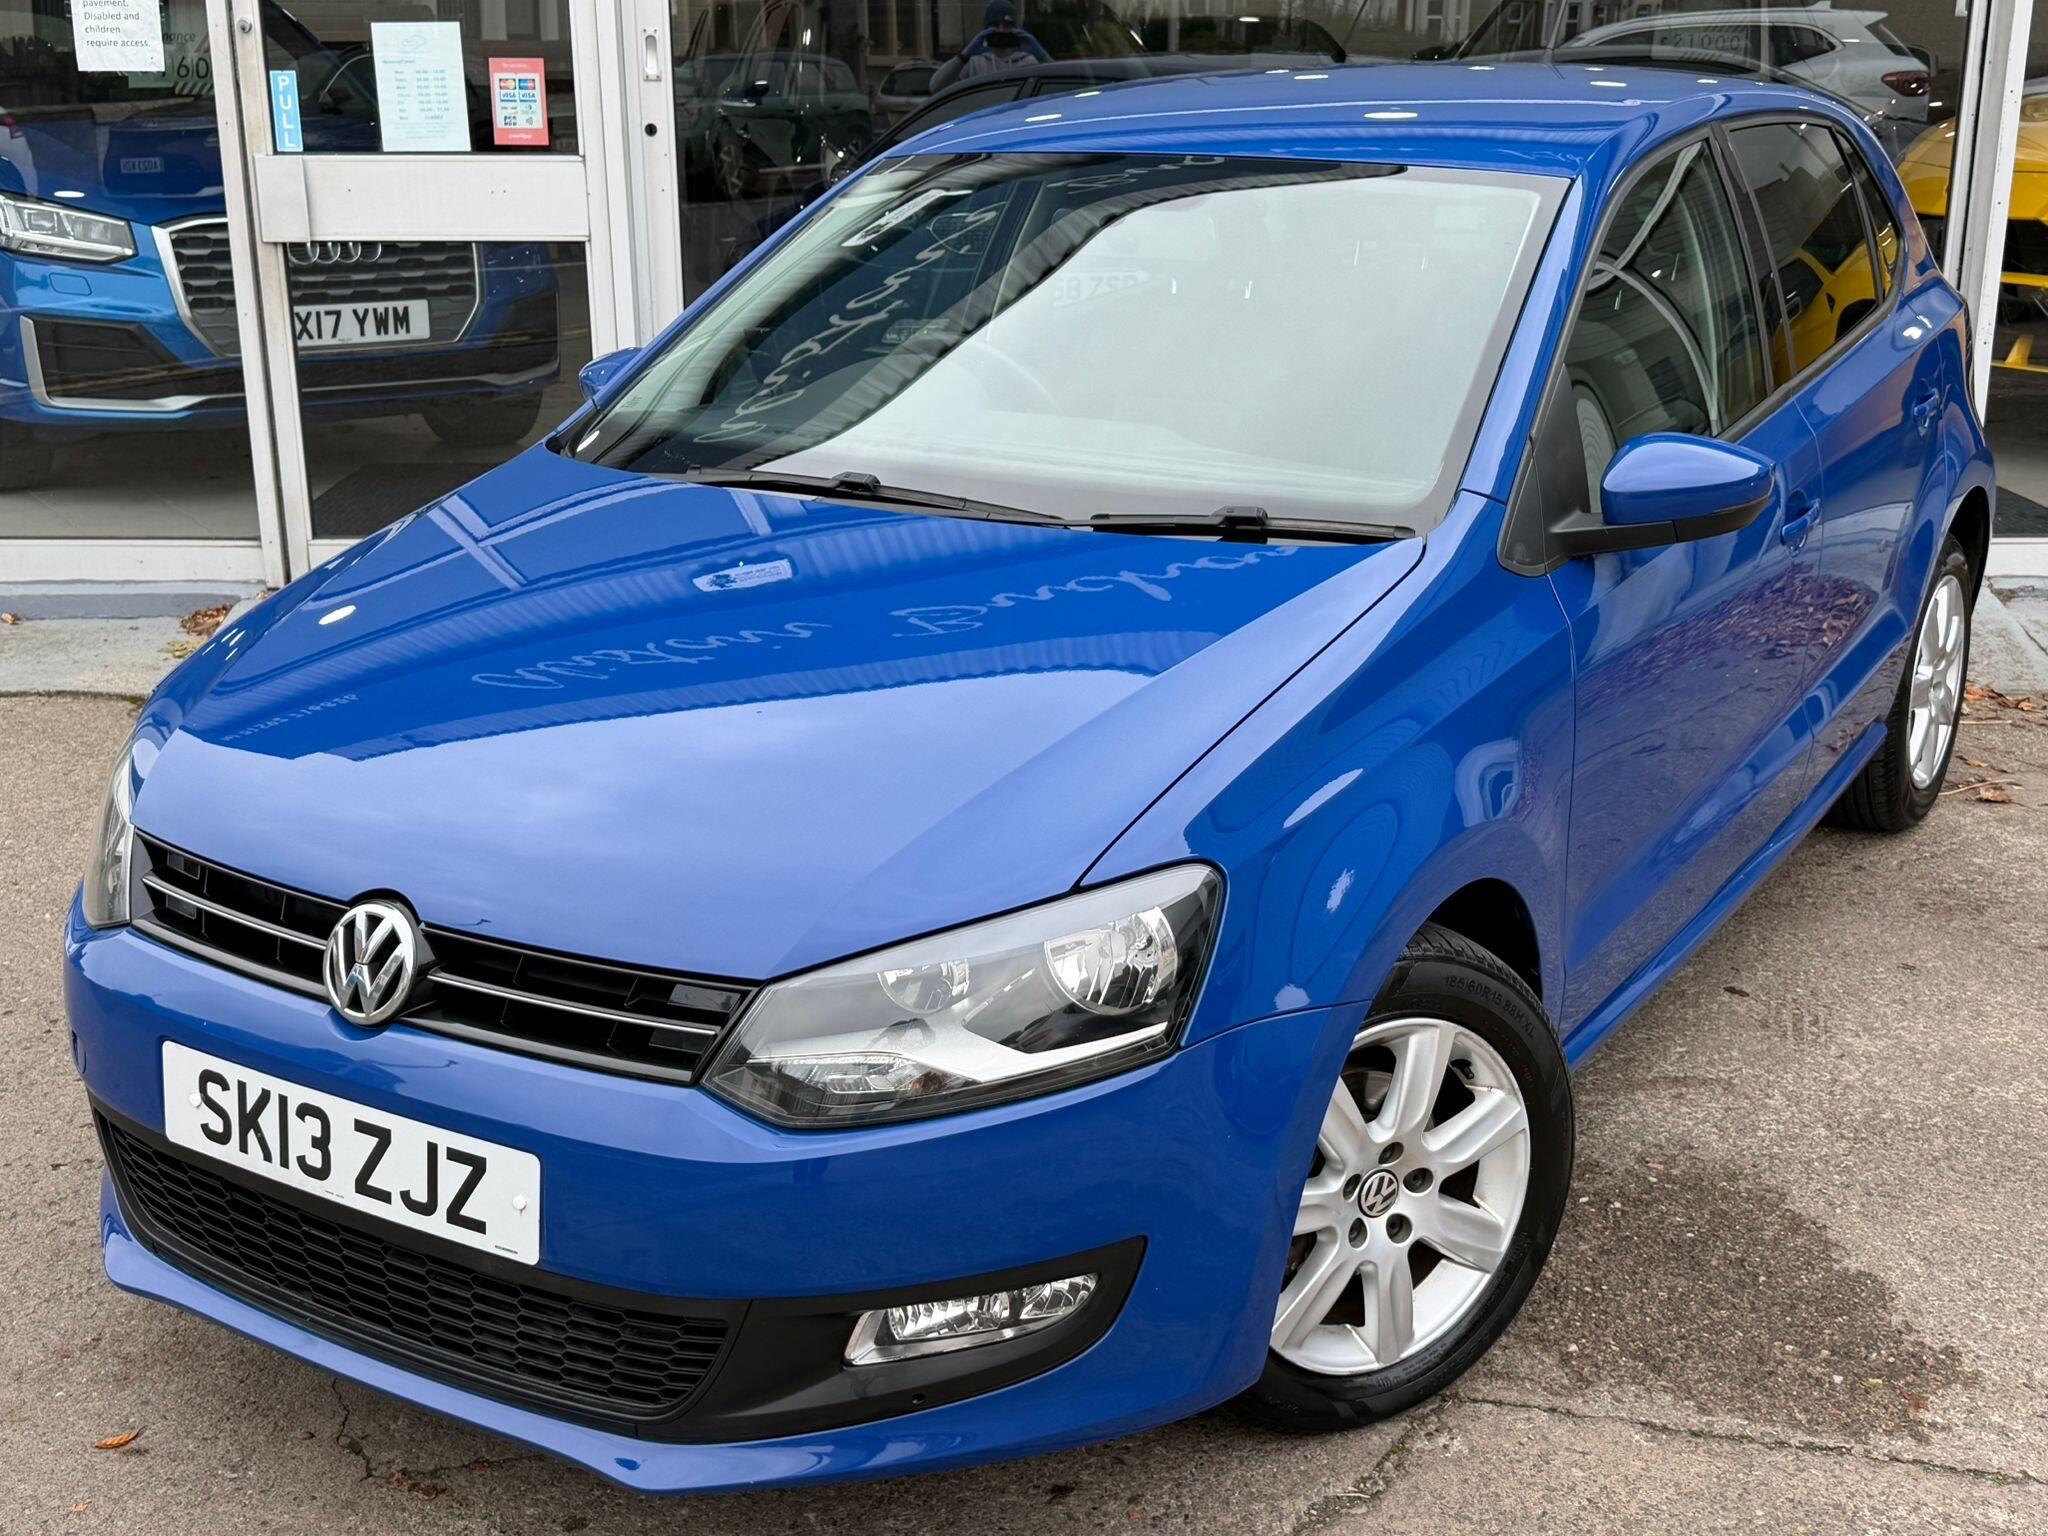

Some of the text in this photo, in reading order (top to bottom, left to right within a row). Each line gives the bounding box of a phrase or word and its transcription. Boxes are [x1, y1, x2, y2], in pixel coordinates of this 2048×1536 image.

[84, 11, 140, 21] Disabled and
[84, 25, 121, 34] children
[86, 40, 151, 48] require access.
[277, 75, 297, 148] PULL
[352, 305, 411, 337] YWM
[199, 1068, 488, 1236] SK13 ZJZ
